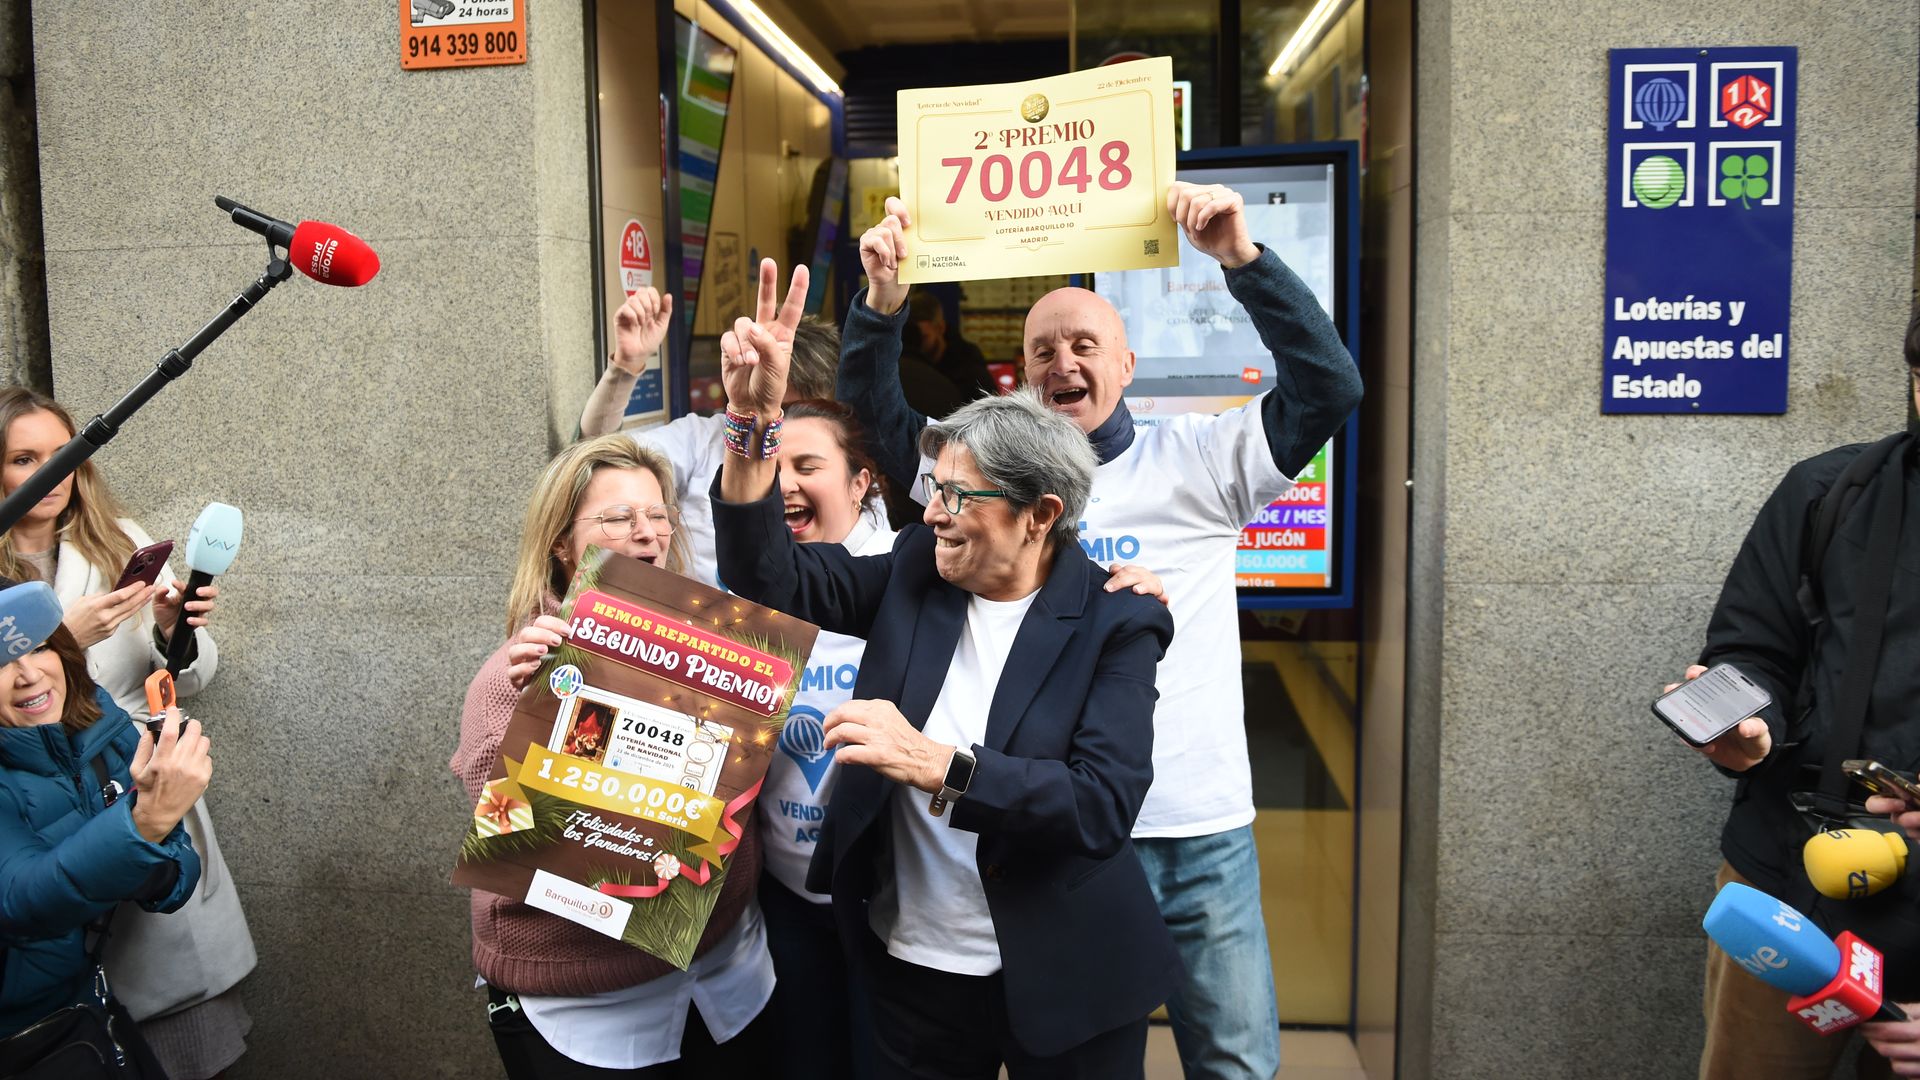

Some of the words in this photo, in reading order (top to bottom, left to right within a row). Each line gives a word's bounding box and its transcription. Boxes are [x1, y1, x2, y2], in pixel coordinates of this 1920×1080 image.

[458, 7, 472, 18] 24
[476, 6, 509, 17] horas
[408, 34, 442, 58] 914
[446, 32, 479, 56] 339
[485, 31, 518, 54] 800
[999, 119, 1095, 149] PREMIO
[941, 140, 1132, 204] 70048
[984, 206, 1044, 222] VENDIDO
[1047, 200, 1082, 217] AQUÍ
[996, 226, 1024, 235] LOTERÍA
[1025, 223, 1065, 233] BARQUILLO
[1020, 236, 1049, 244] MADRID
[311, 241, 323, 274] press
[321, 239, 339, 279] europa
[626, 230, 645, 260] +18
[1614, 295, 1722, 322] Loterías
[1728, 300, 1746, 327] y
[1612, 335, 1734, 366] Apuestas
[1741, 333, 1783, 359] del
[1612, 373, 1702, 400] Estado
[1293, 509, 1326, 525] MES
[1254, 529, 1306, 549] JUGÓN
[592, 601, 652, 633] HEMOS
[654, 625, 751, 668] REPARTIDO
[752, 659, 775, 678] EL
[568, 617, 680, 671] ¡SEGUNDO
[685, 654, 777, 712] PREMIO!
[801, 663, 859, 692] MIO
[616, 734, 646, 747] LOTERÍA
[647, 743, 683, 758] NACIONAL
[621, 717, 685, 747] 70048
[626, 744, 636, 752] DE
[637, 748, 669, 761] NAVIDAD
[537, 758, 704, 822] 1.250.000€
[633, 806, 641, 815] a
[643, 806, 655, 818] la
[656, 812, 689, 829] Serie
[563, 825, 584, 842] los
[583, 831, 664, 863] Ganadores!
[643, 838, 654, 847] a
